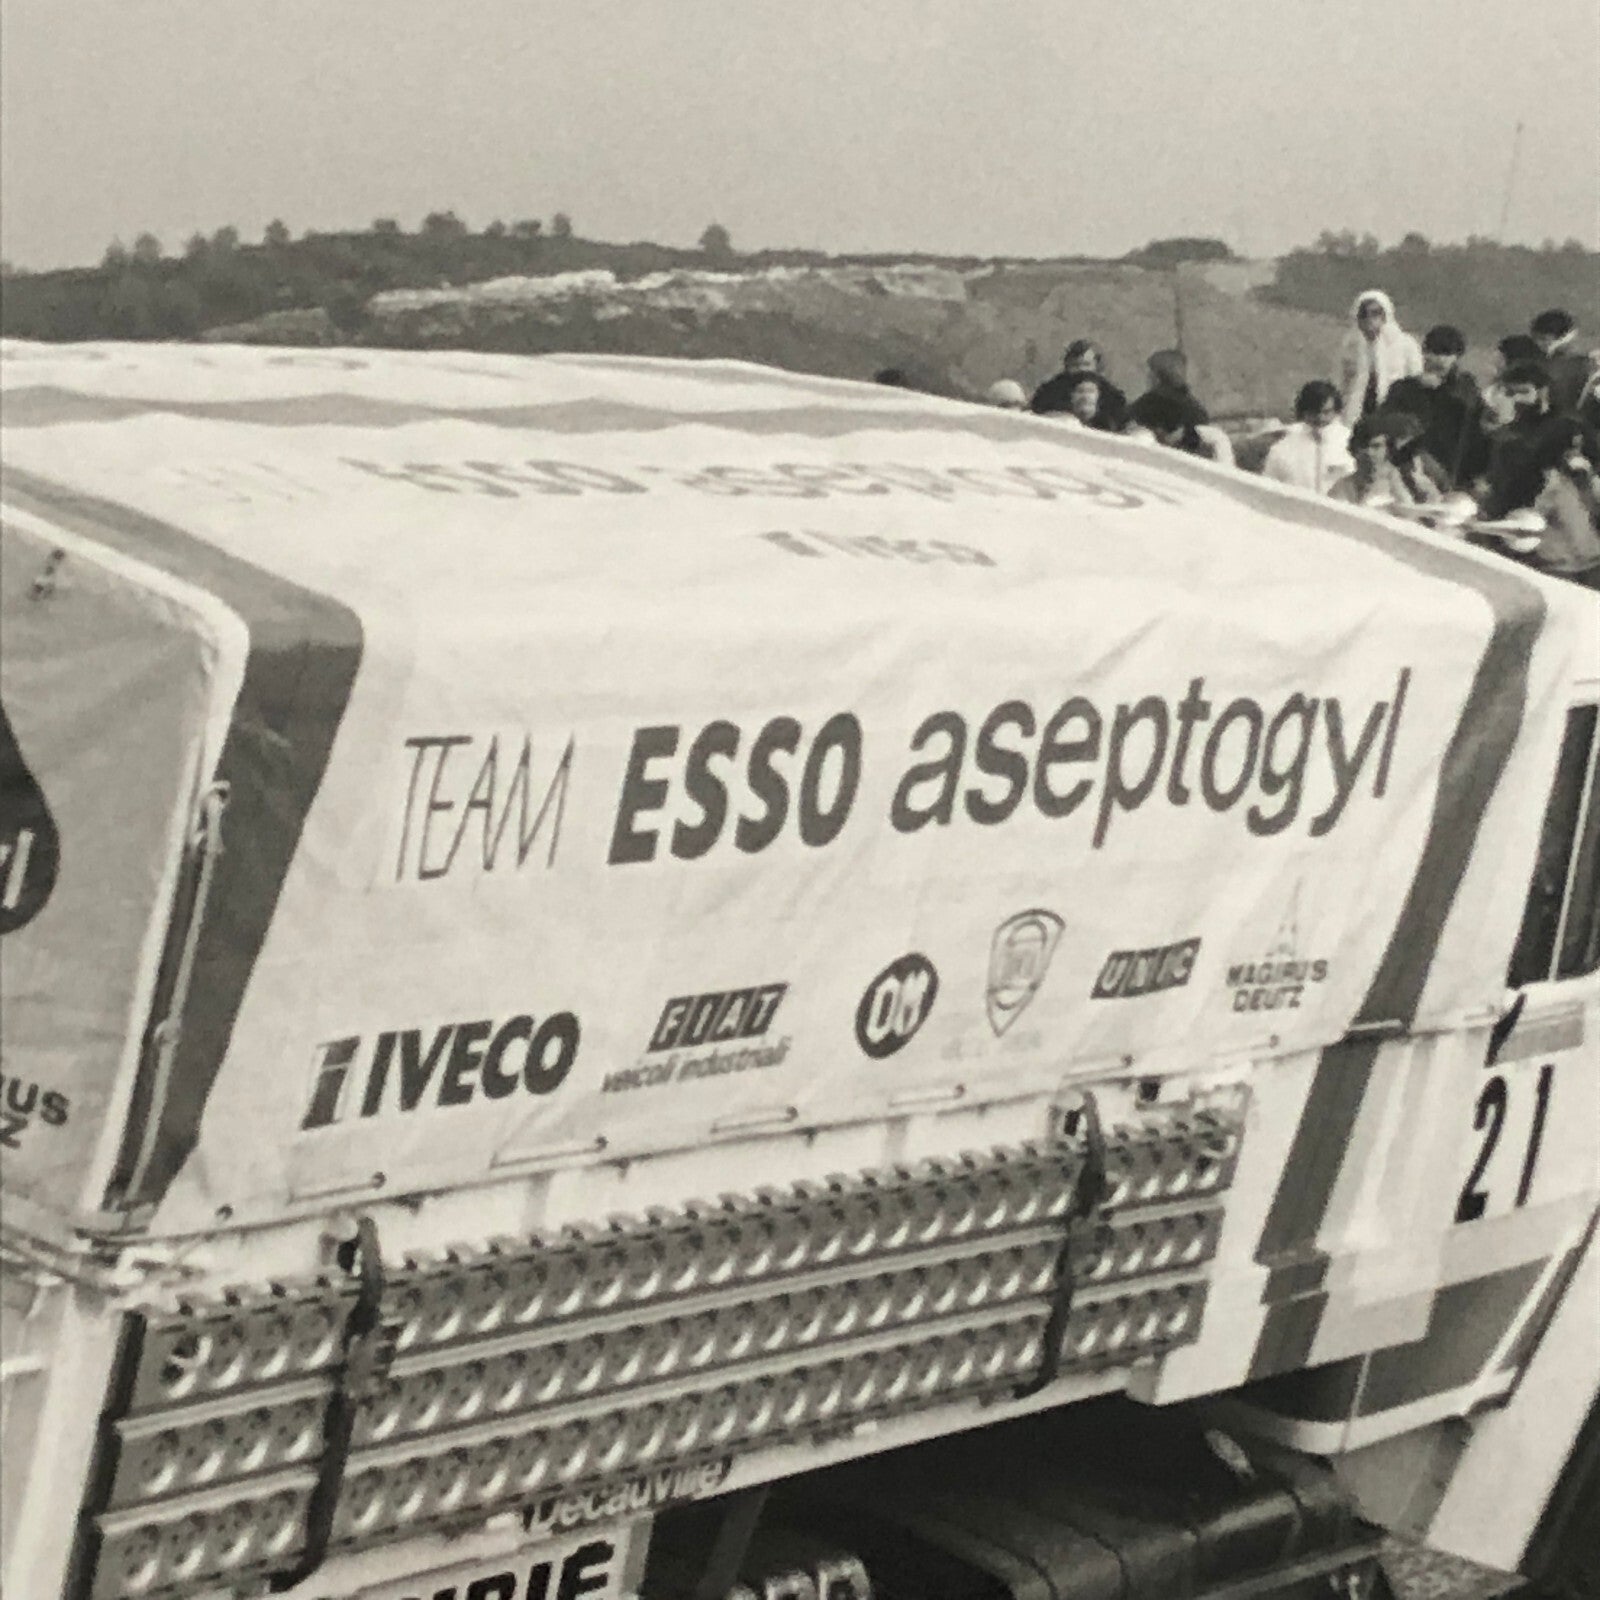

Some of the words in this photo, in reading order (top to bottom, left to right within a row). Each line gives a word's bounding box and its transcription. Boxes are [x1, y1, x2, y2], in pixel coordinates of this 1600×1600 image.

[396, 733, 576, 883] TEAM
[606, 711, 864, 866] ESSO
[889, 666, 1412, 850] aseptogyl
[360, 1010, 582, 1118] IVECO
[653, 986, 786, 1048] FIAT
[0, 1072, 70, 1126] US
[1454, 1063, 1556, 1225] 21
